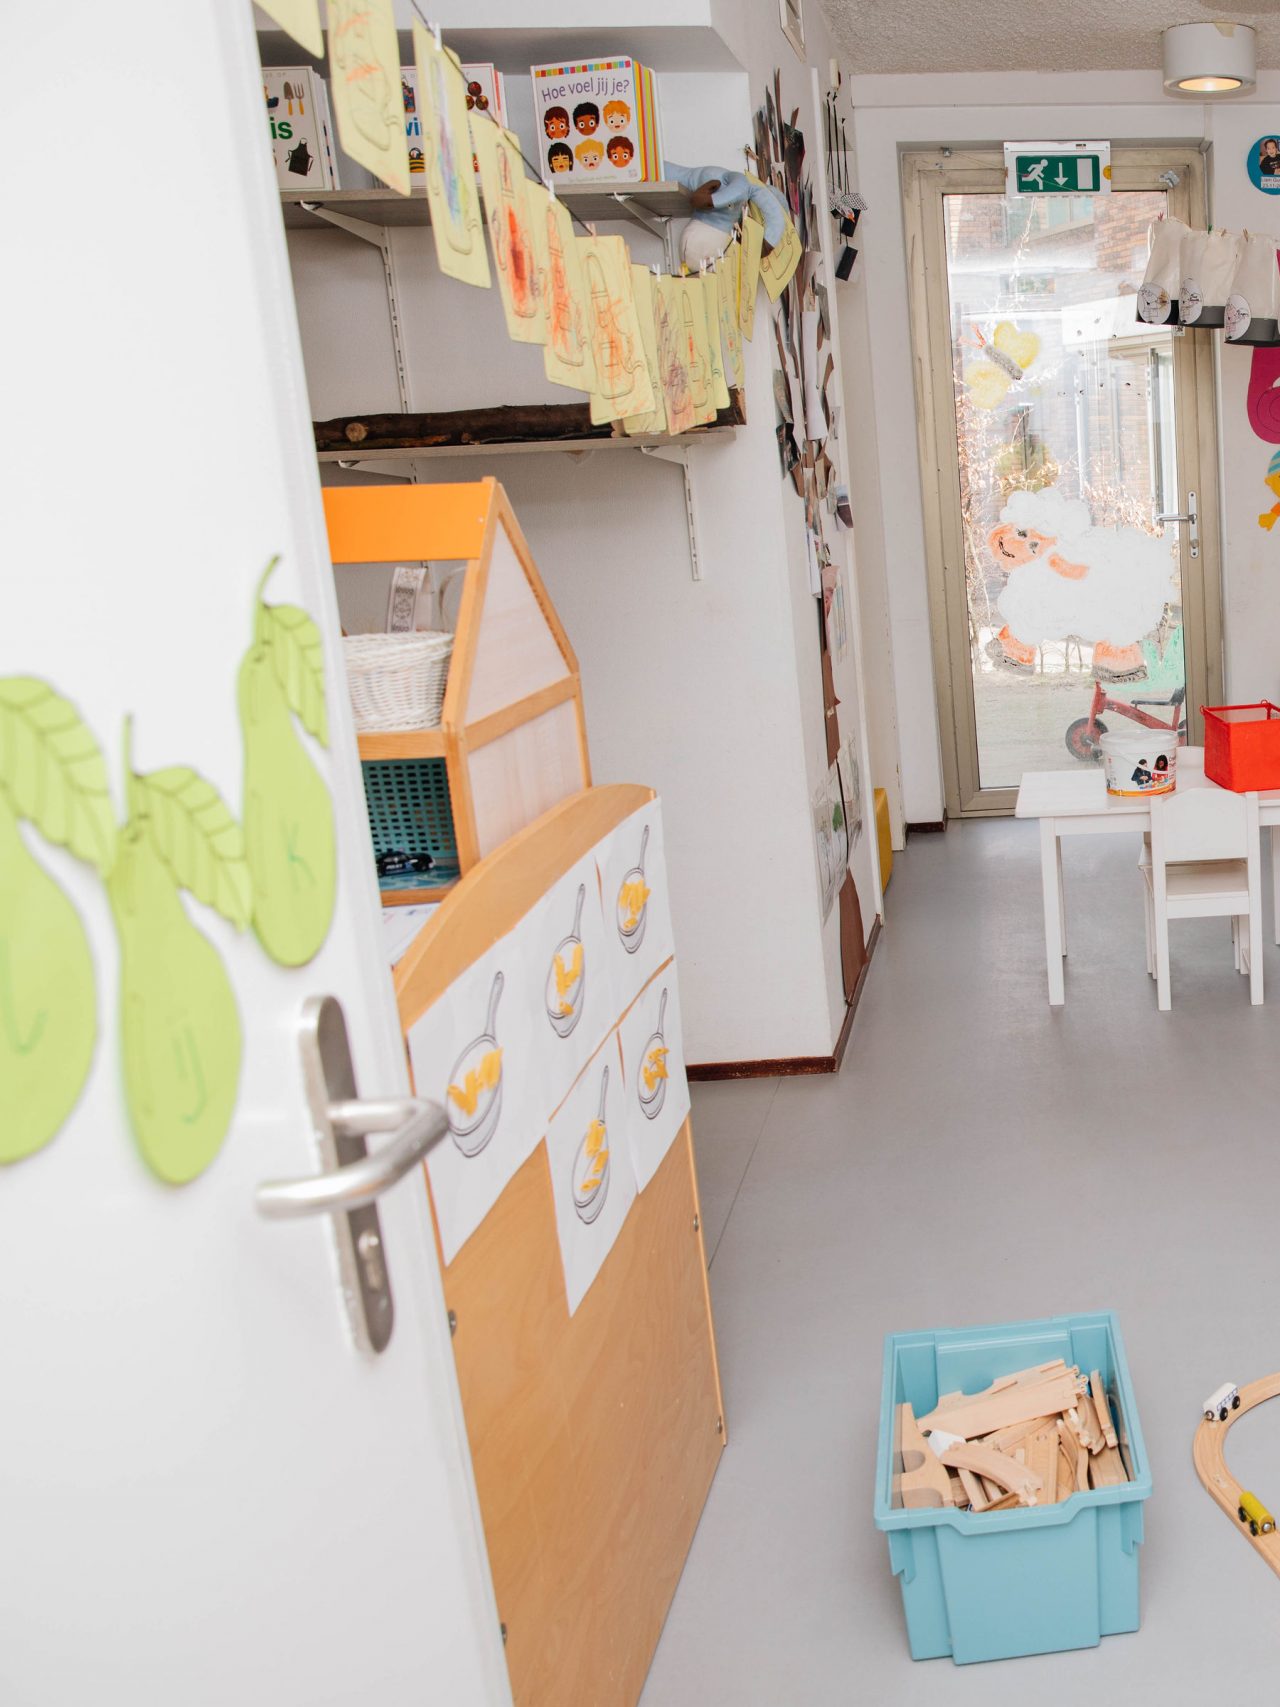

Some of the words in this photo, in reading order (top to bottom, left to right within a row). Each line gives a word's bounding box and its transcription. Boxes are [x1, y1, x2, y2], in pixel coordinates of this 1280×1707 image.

[542, 85, 566, 102] Hoe
[568, 77, 594, 94] voel
[595, 77, 608, 96] jij
[610, 78, 630, 96] je?
